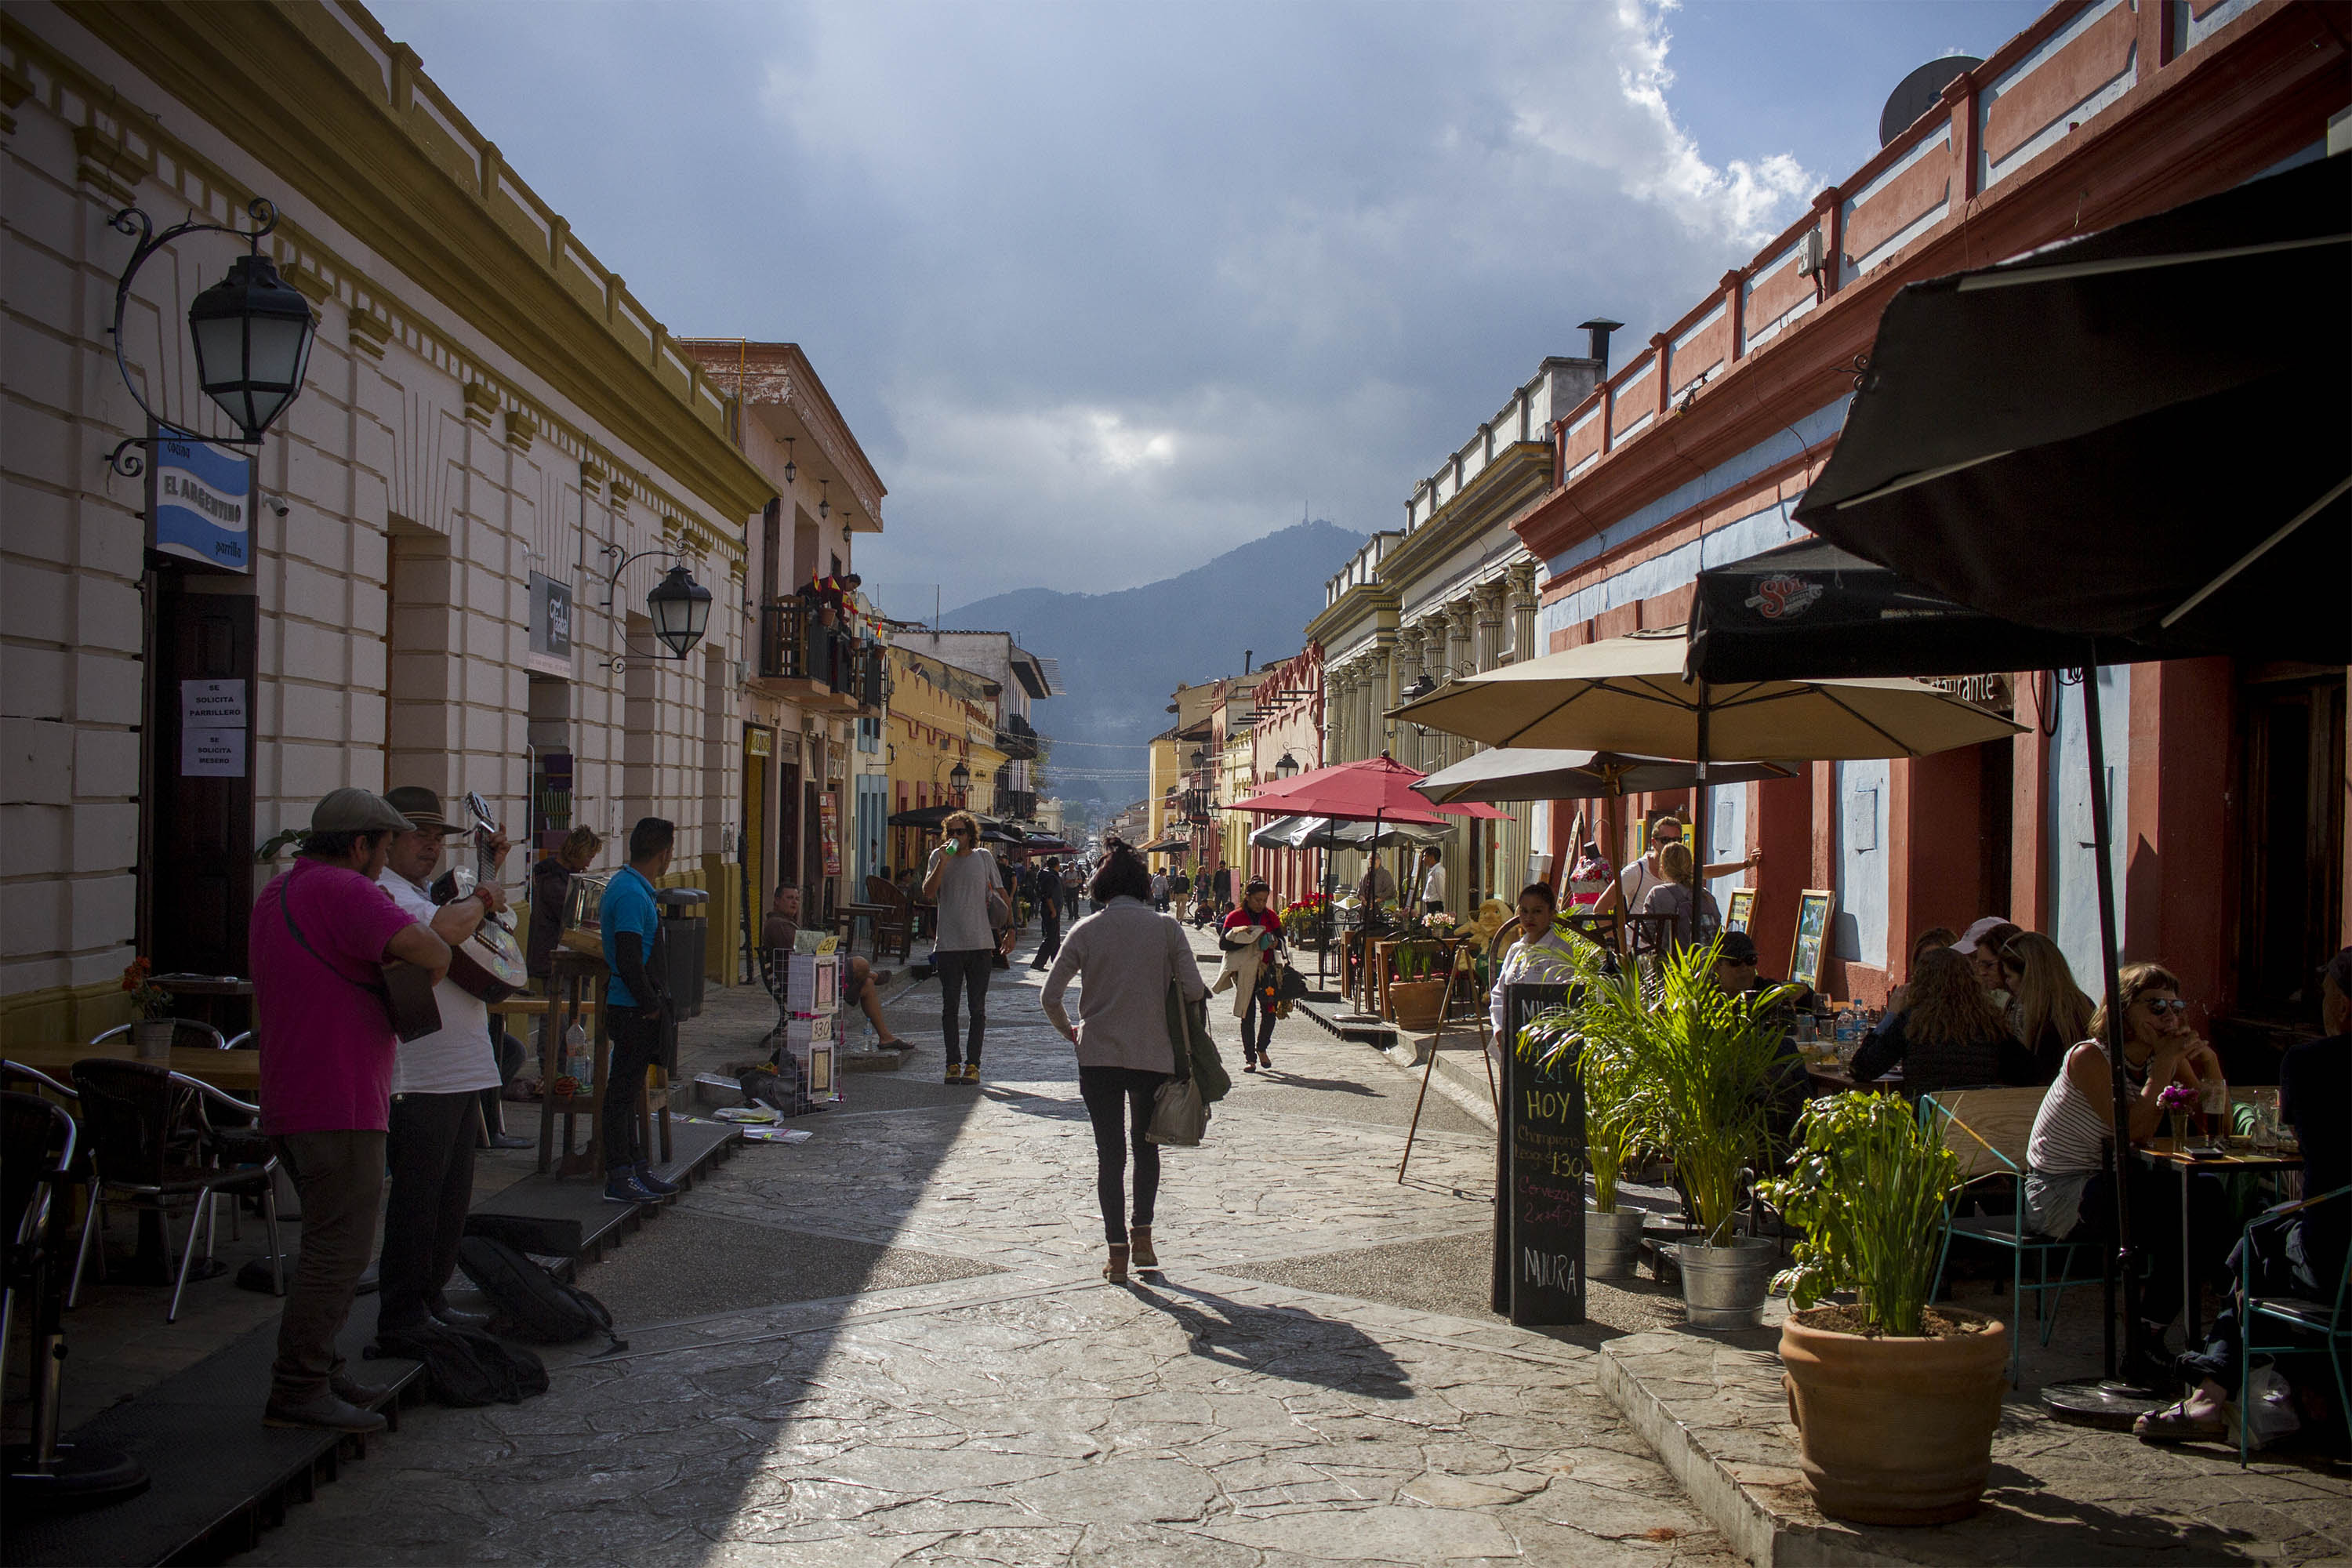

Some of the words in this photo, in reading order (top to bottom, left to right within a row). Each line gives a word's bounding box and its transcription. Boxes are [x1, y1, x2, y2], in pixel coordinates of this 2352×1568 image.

[167, 441, 191, 459] cocina
[164, 475, 179, 495] EL
[180, 479, 241, 523] ARGENTINO
[216, 541, 241, 559] parrilla
[815, 1021, 829, 1036] $30
[1526, 1090, 1571, 1123] HOY
[1525, 1247, 1577, 1297] MIURA
